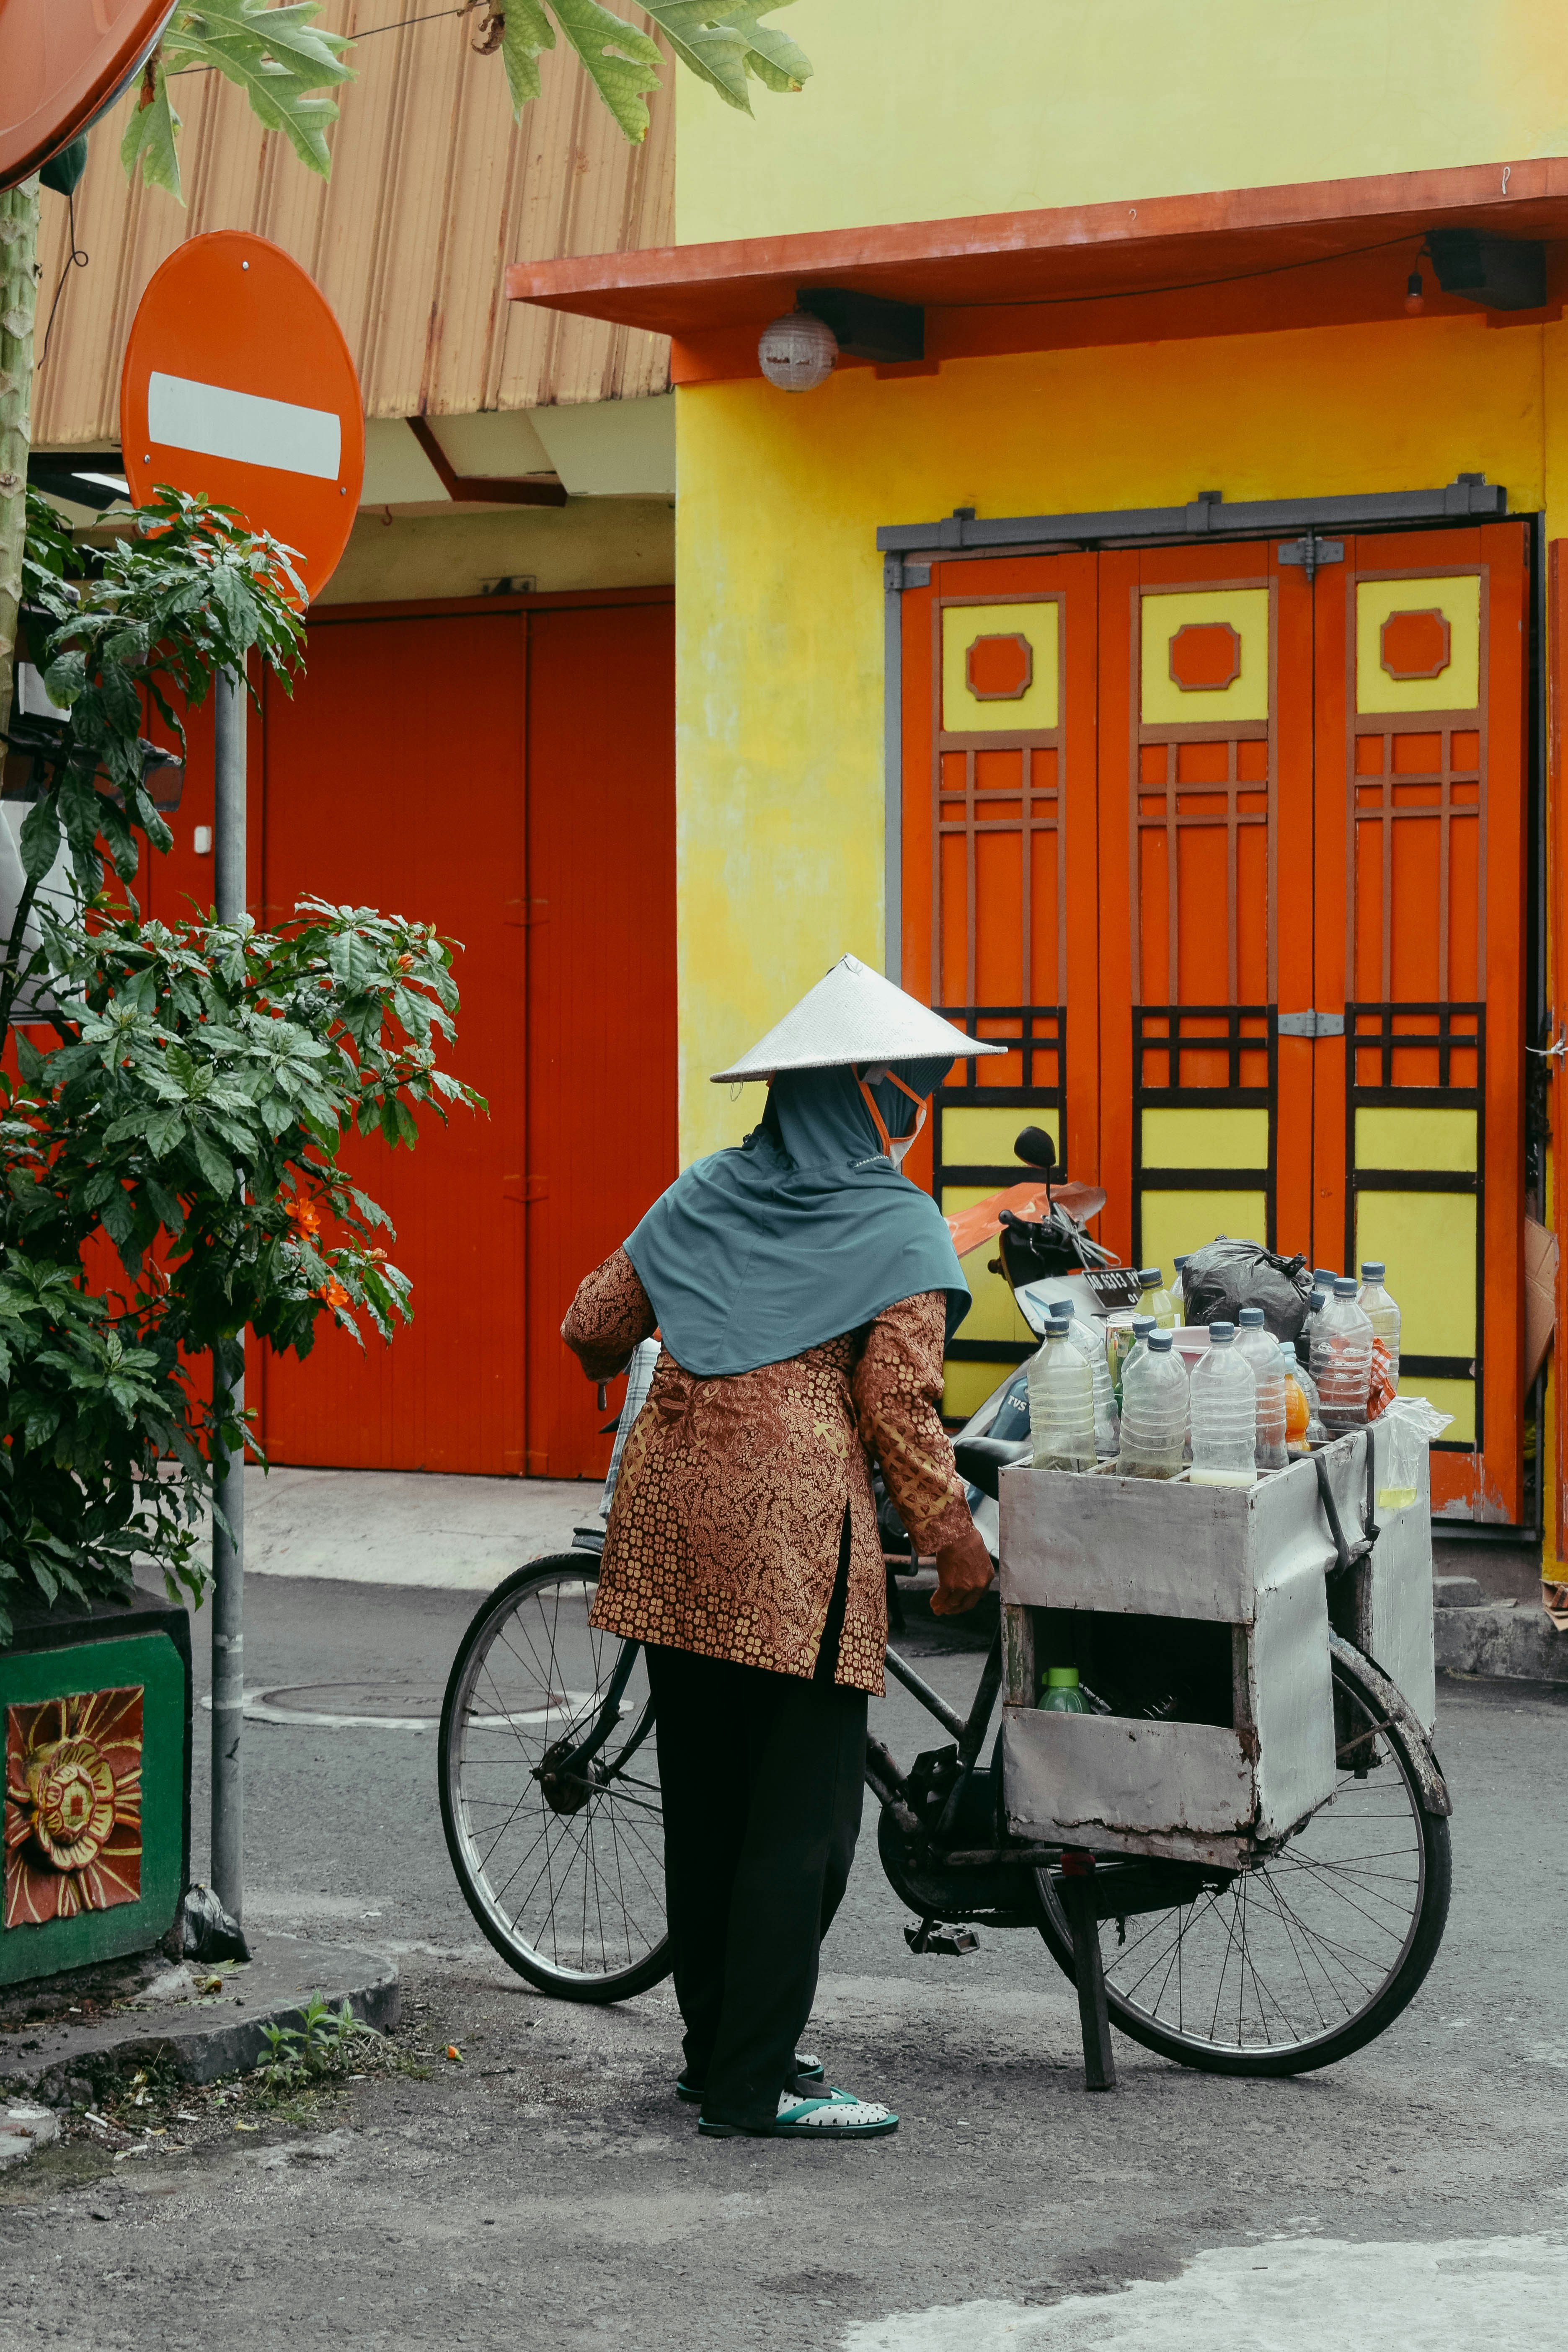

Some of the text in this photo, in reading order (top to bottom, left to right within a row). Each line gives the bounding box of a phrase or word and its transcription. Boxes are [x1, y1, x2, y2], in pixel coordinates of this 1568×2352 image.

[1087, 1275, 1103, 1290] AB
[1100, 1273, 1127, 1289] 6313
[1008, 1395, 1027, 1411] TVS
